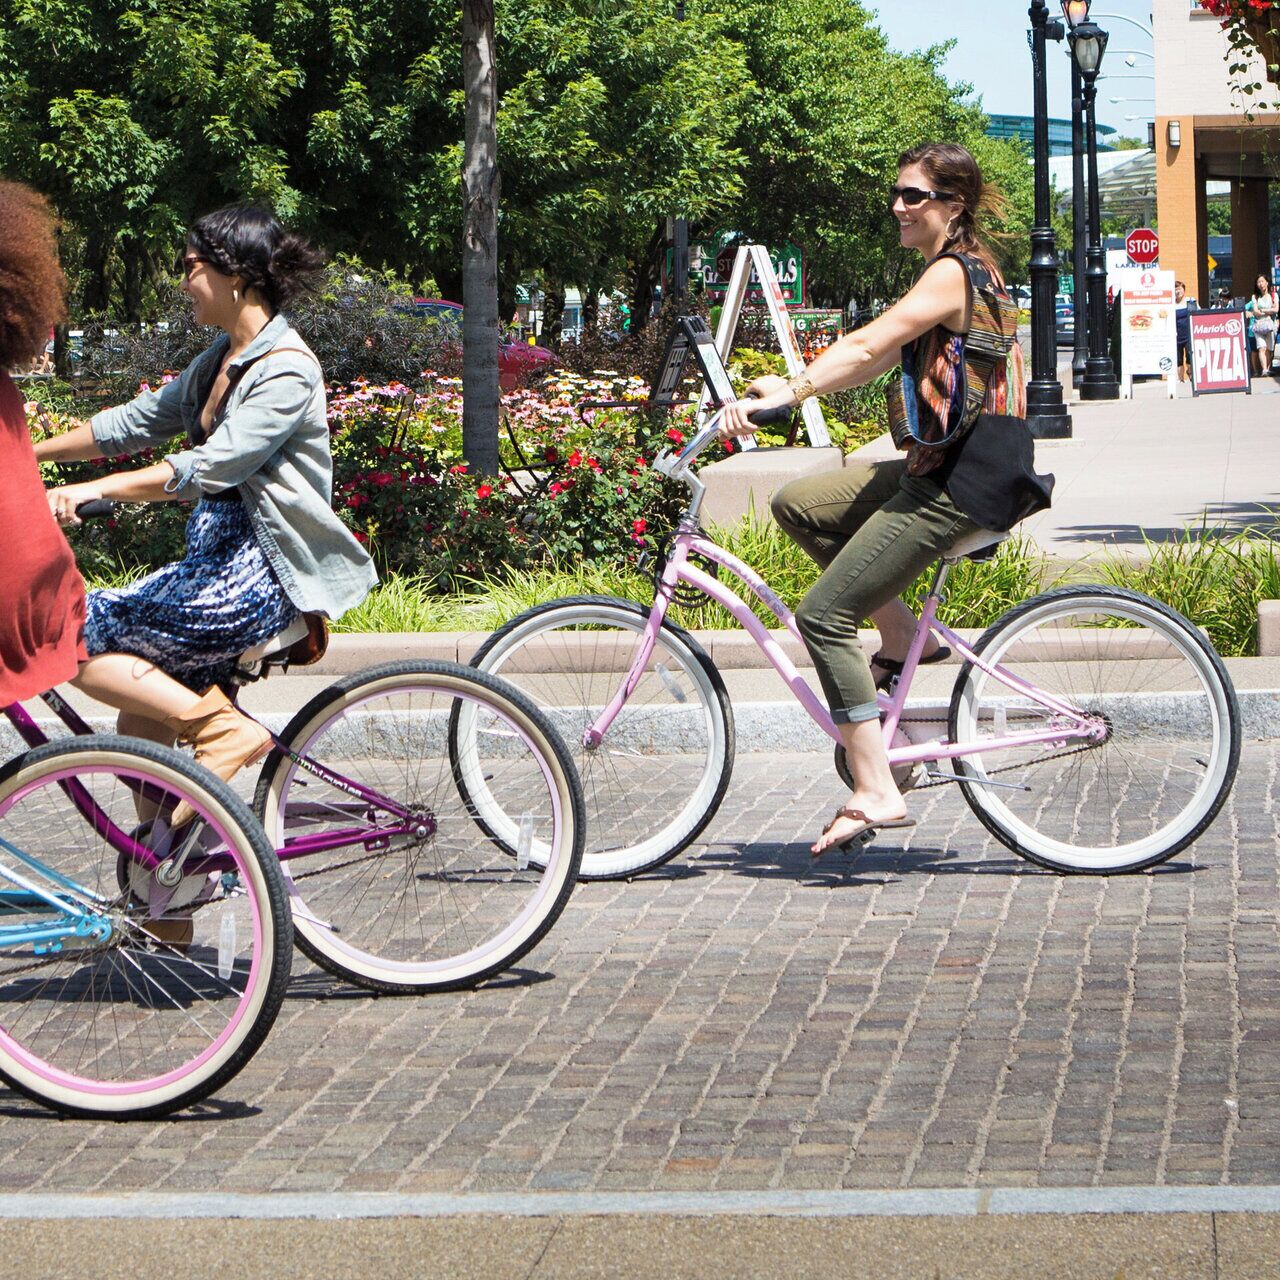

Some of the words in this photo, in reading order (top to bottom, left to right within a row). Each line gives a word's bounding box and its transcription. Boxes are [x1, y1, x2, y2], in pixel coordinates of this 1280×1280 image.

[1128, 239, 1158, 254] STOP
[1193, 323, 1226, 335] Mario's
[1195, 337, 1245, 384] PIZZA
